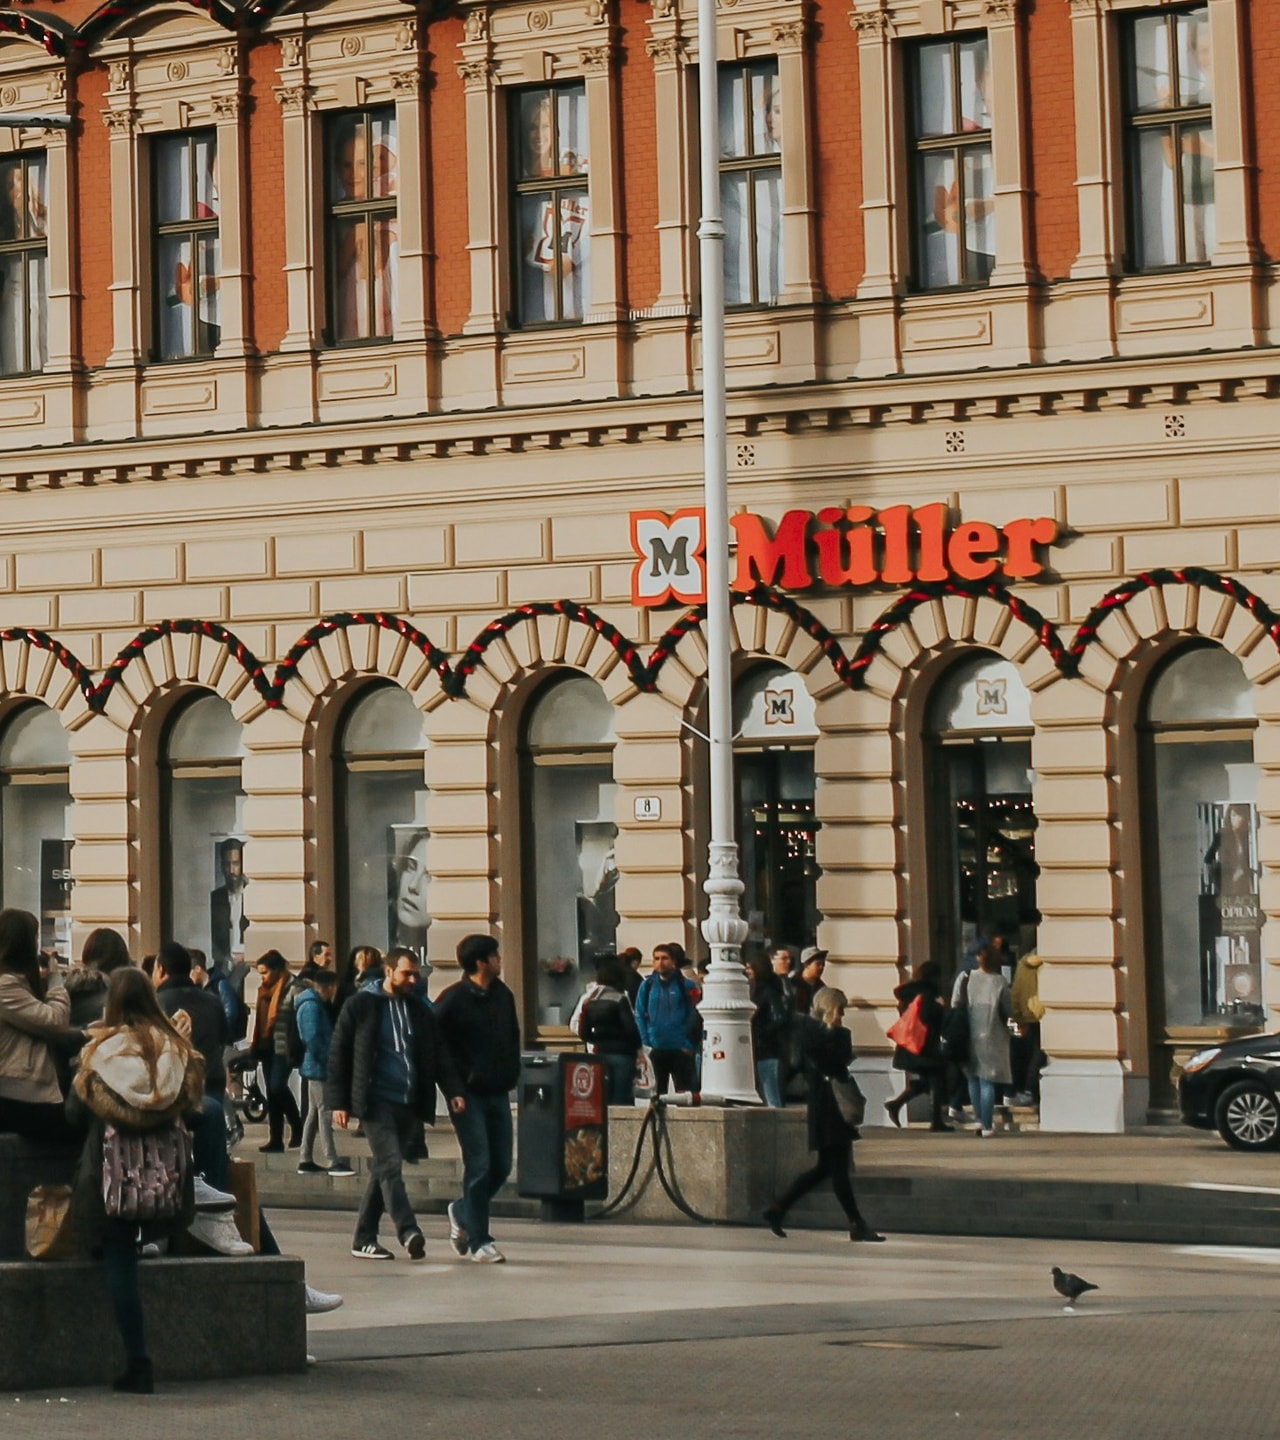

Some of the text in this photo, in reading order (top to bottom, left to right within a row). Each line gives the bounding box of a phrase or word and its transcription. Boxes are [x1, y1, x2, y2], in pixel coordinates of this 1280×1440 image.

[649, 536, 690, 578] M
[728, 502, 1058, 593] Müller
[644, 799, 651, 812] 8
